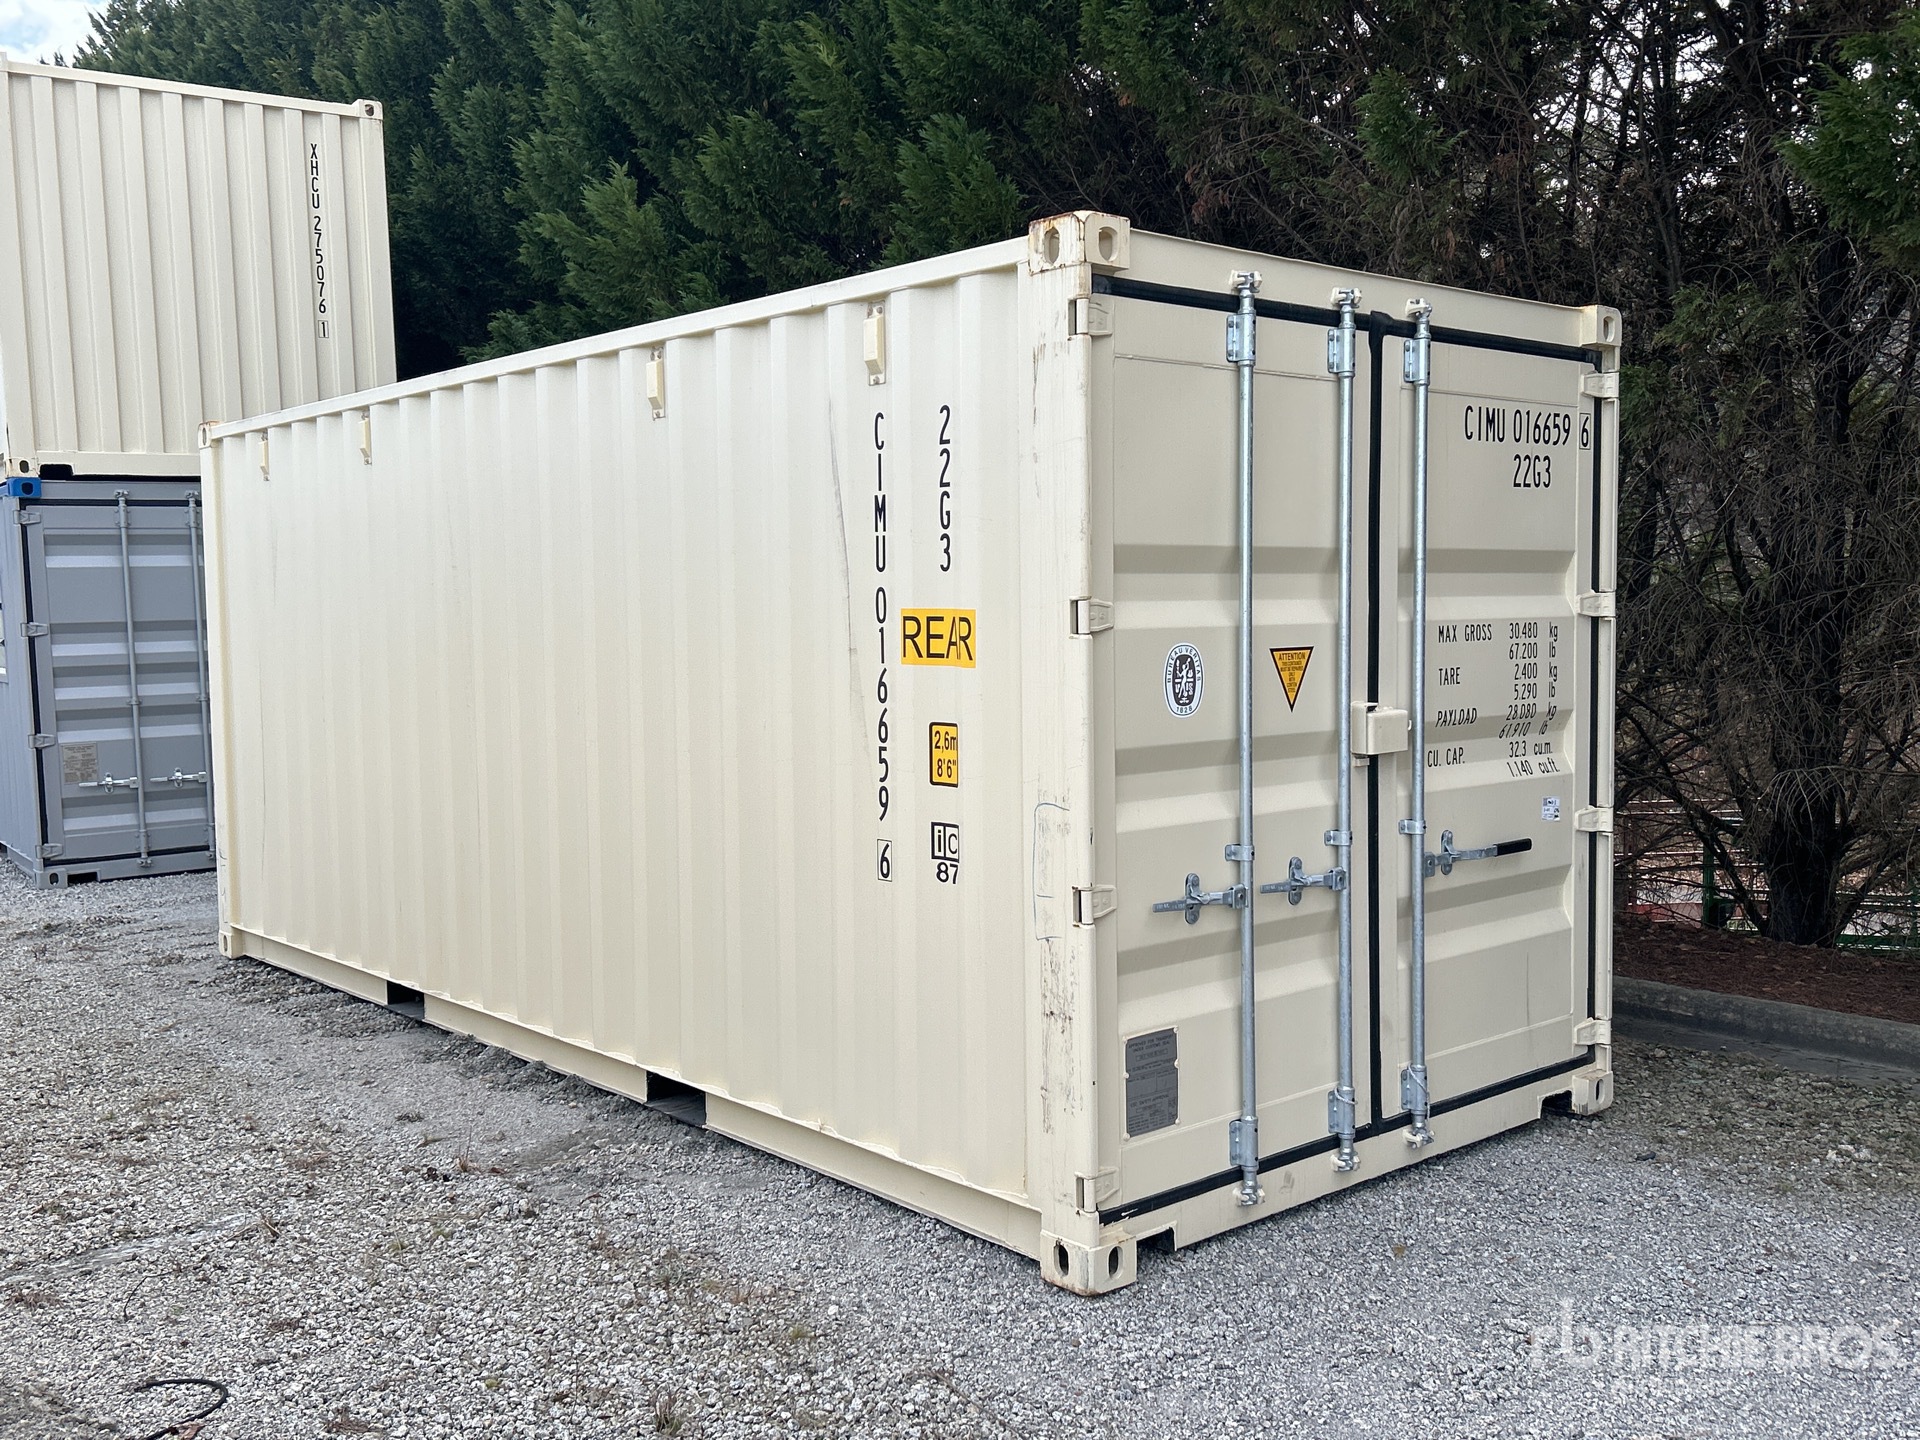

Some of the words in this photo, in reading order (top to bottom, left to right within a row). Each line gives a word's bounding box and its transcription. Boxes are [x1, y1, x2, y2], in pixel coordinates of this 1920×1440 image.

[310, 143, 320, 209] XHCU
[313, 215, 327, 314] 275076
[1464, 405, 1506, 442] CIMU
[1513, 409, 1571, 446] 016659
[1580, 415, 1590, 448] 6
[1513, 454, 1551, 488] 22G3
[874, 412, 887, 573] CIMU
[939, 404, 951, 572] 22G3
[902, 616, 974, 661] REAR
[1438, 625, 1458, 643] MAX
[1464, 623, 1493, 642] GROSS
[1549, 621, 1558, 642] kg
[1279, 652, 1306, 661] ATTENTION
[1548, 641, 1556, 658] lb
[1438, 667, 1461, 686] TARE
[1548, 661, 1558, 682] kg
[1548, 681, 1556, 698] lb
[875, 586, 889, 822] 016659
[1176, 706, 1193, 714] 1828
[1435, 707, 1478, 728] PAYLOAD
[1546, 701, 1557, 721] kg
[1538, 720, 1548, 735] lb
[1427, 750, 1442, 768] CU.
[1446, 746, 1466, 766] CAP.
[1508, 740, 1527, 758] 32.3
[879, 842, 891, 880] 6
[936, 861, 959, 885] 87
